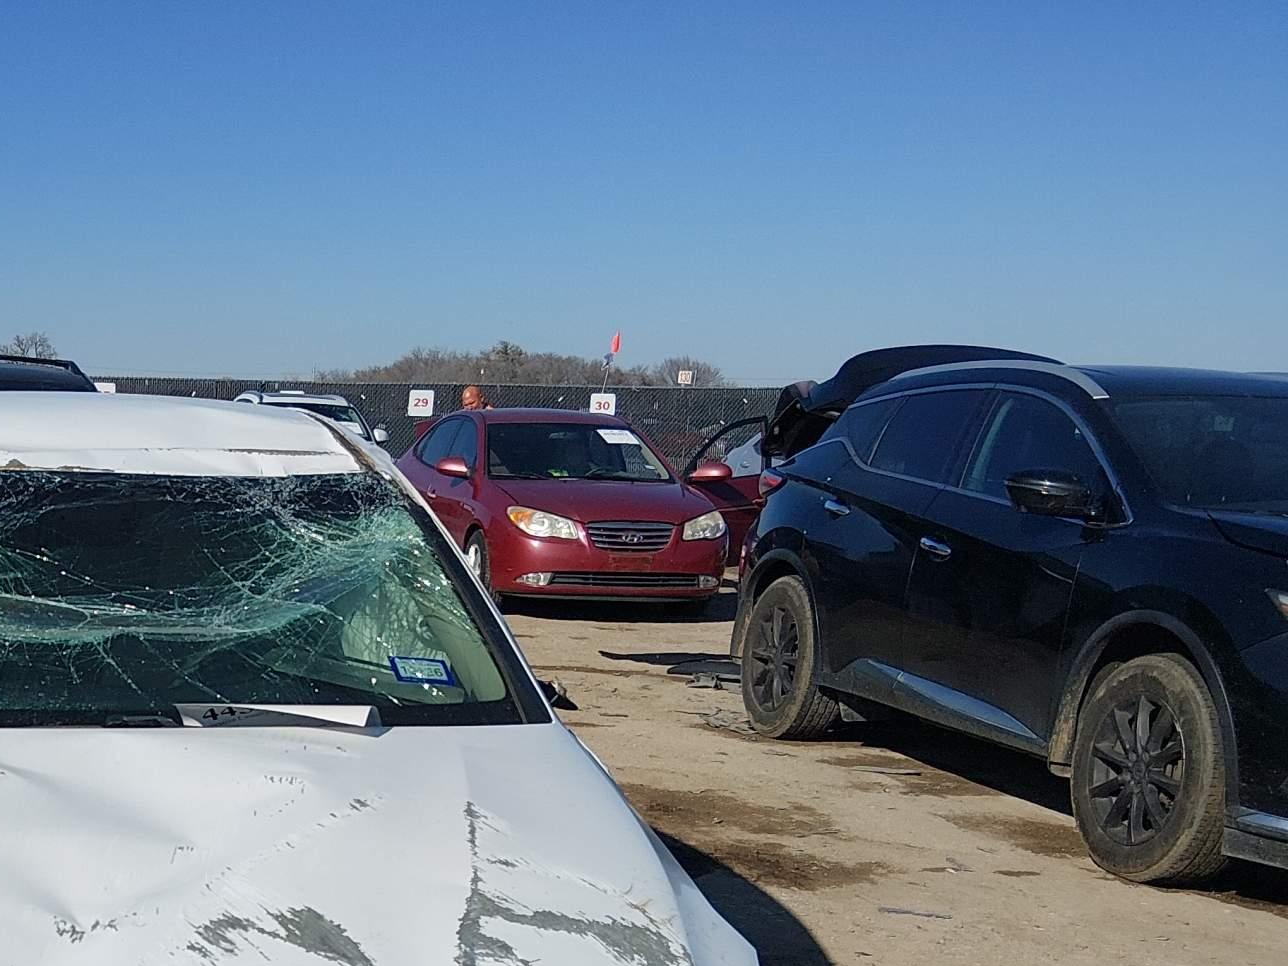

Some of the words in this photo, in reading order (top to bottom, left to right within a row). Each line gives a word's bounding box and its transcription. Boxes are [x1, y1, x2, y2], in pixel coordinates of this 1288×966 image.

[679, 372, 691, 383] 130
[413, 398, 429, 408] 29
[595, 401, 610, 411] 30
